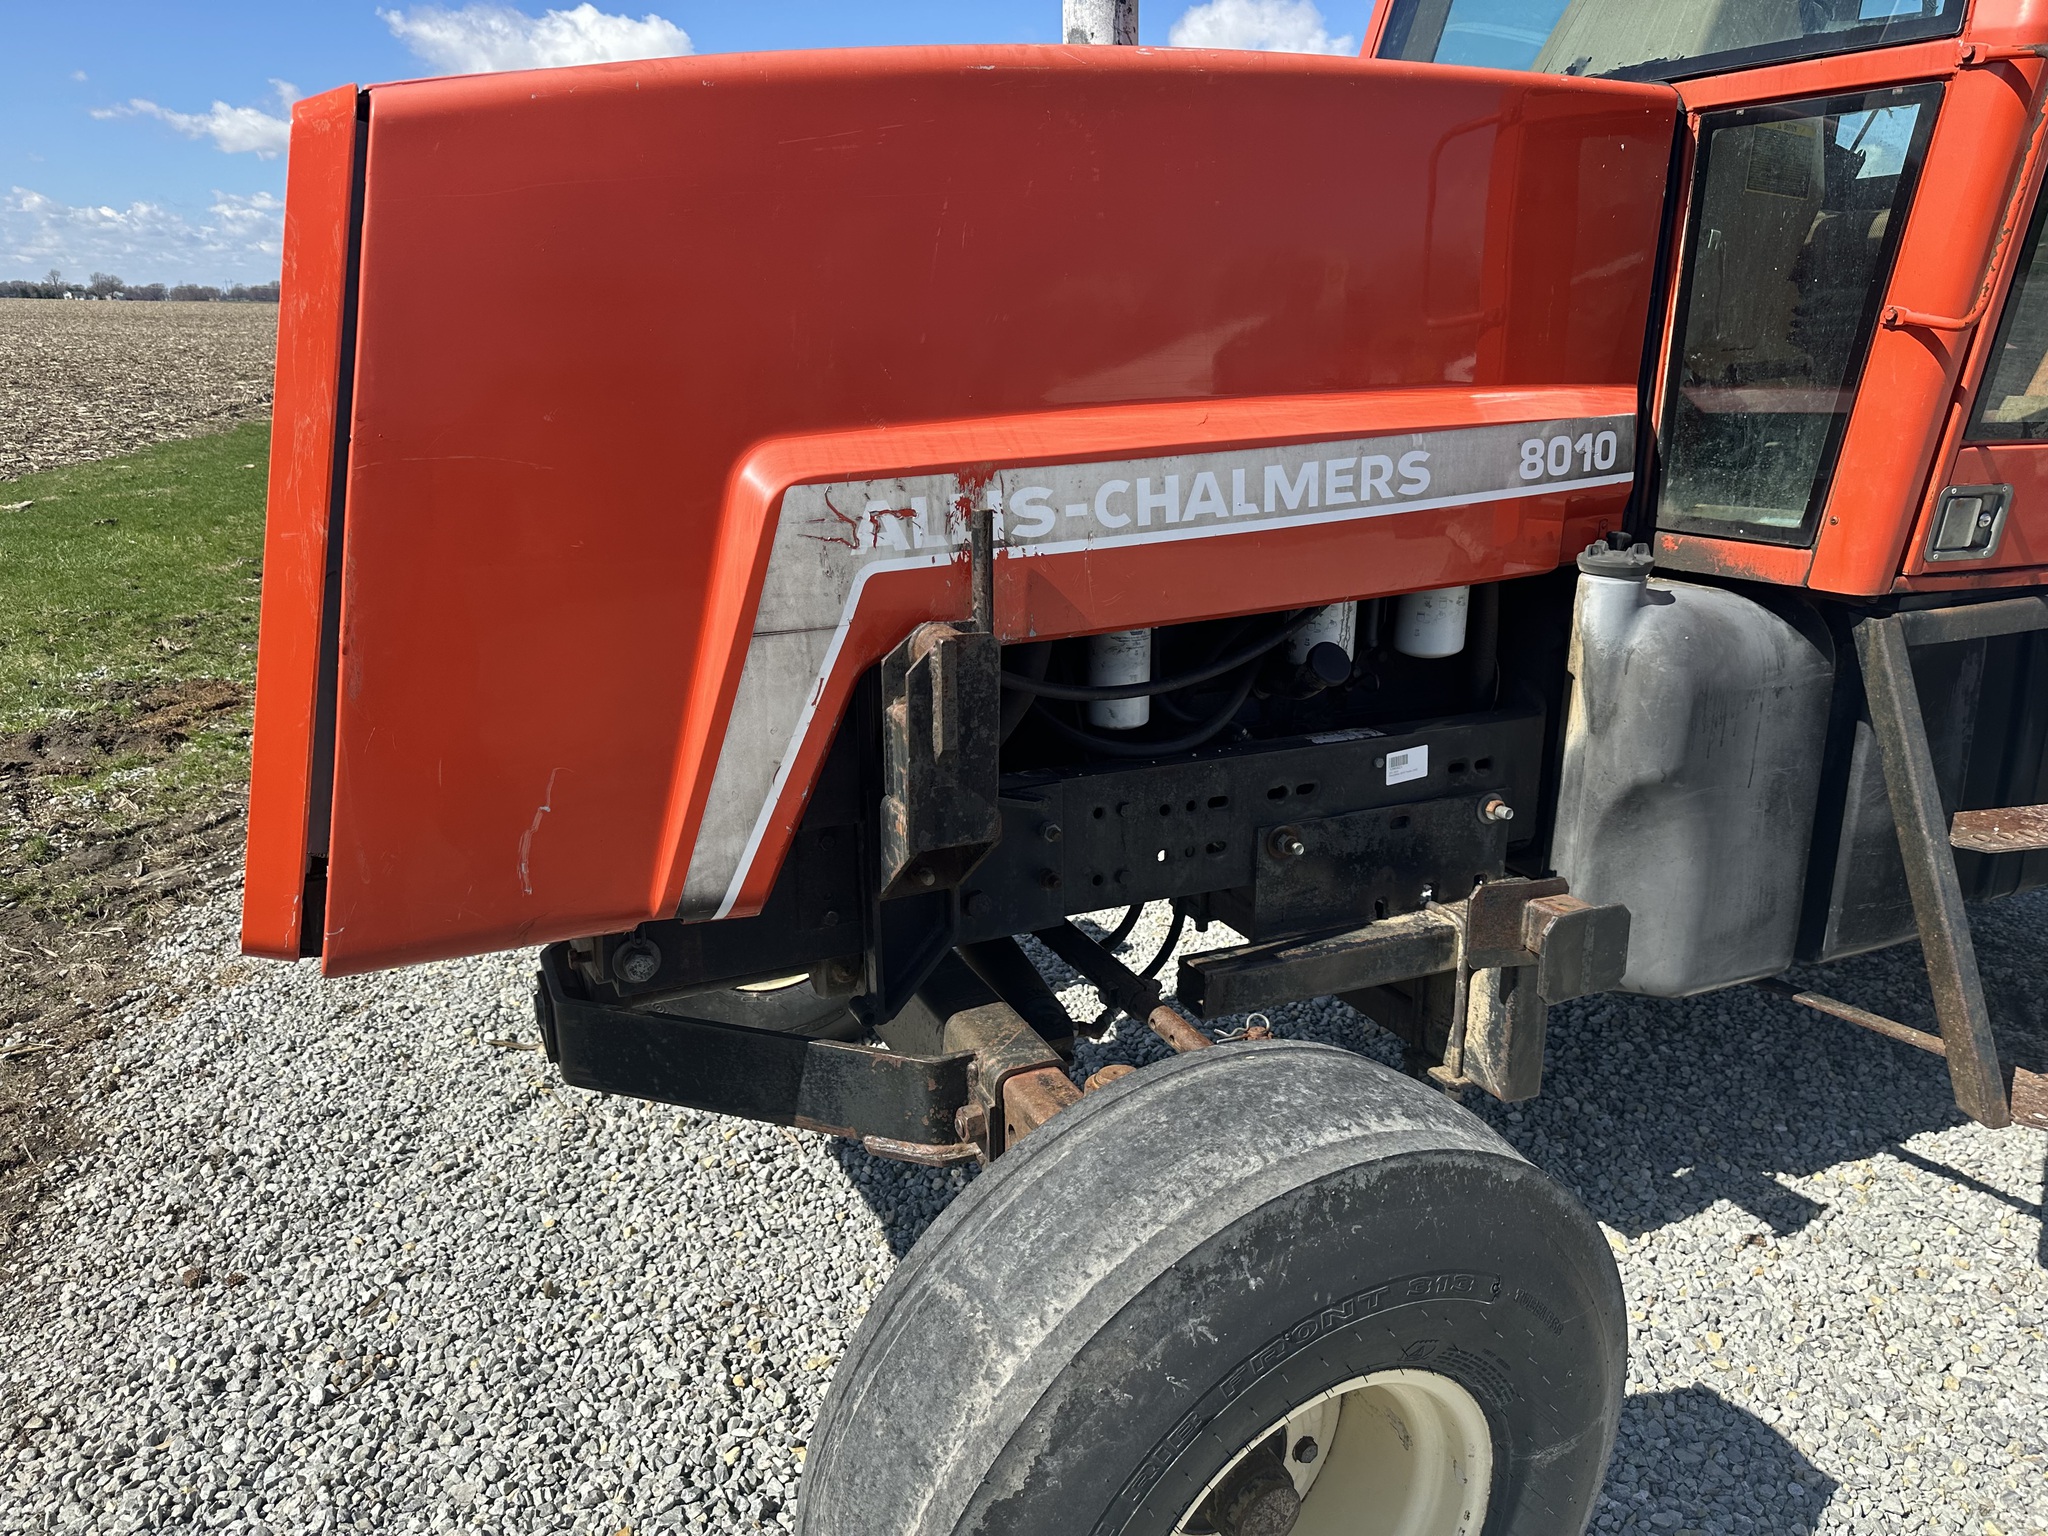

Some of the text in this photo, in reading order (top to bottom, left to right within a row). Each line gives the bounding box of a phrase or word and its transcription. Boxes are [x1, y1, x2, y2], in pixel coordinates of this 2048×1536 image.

[1519, 430, 1616, 480] 8010
[1220, 1286, 1390, 1399] FRONT
[1406, 1273, 1476, 1297] 313
